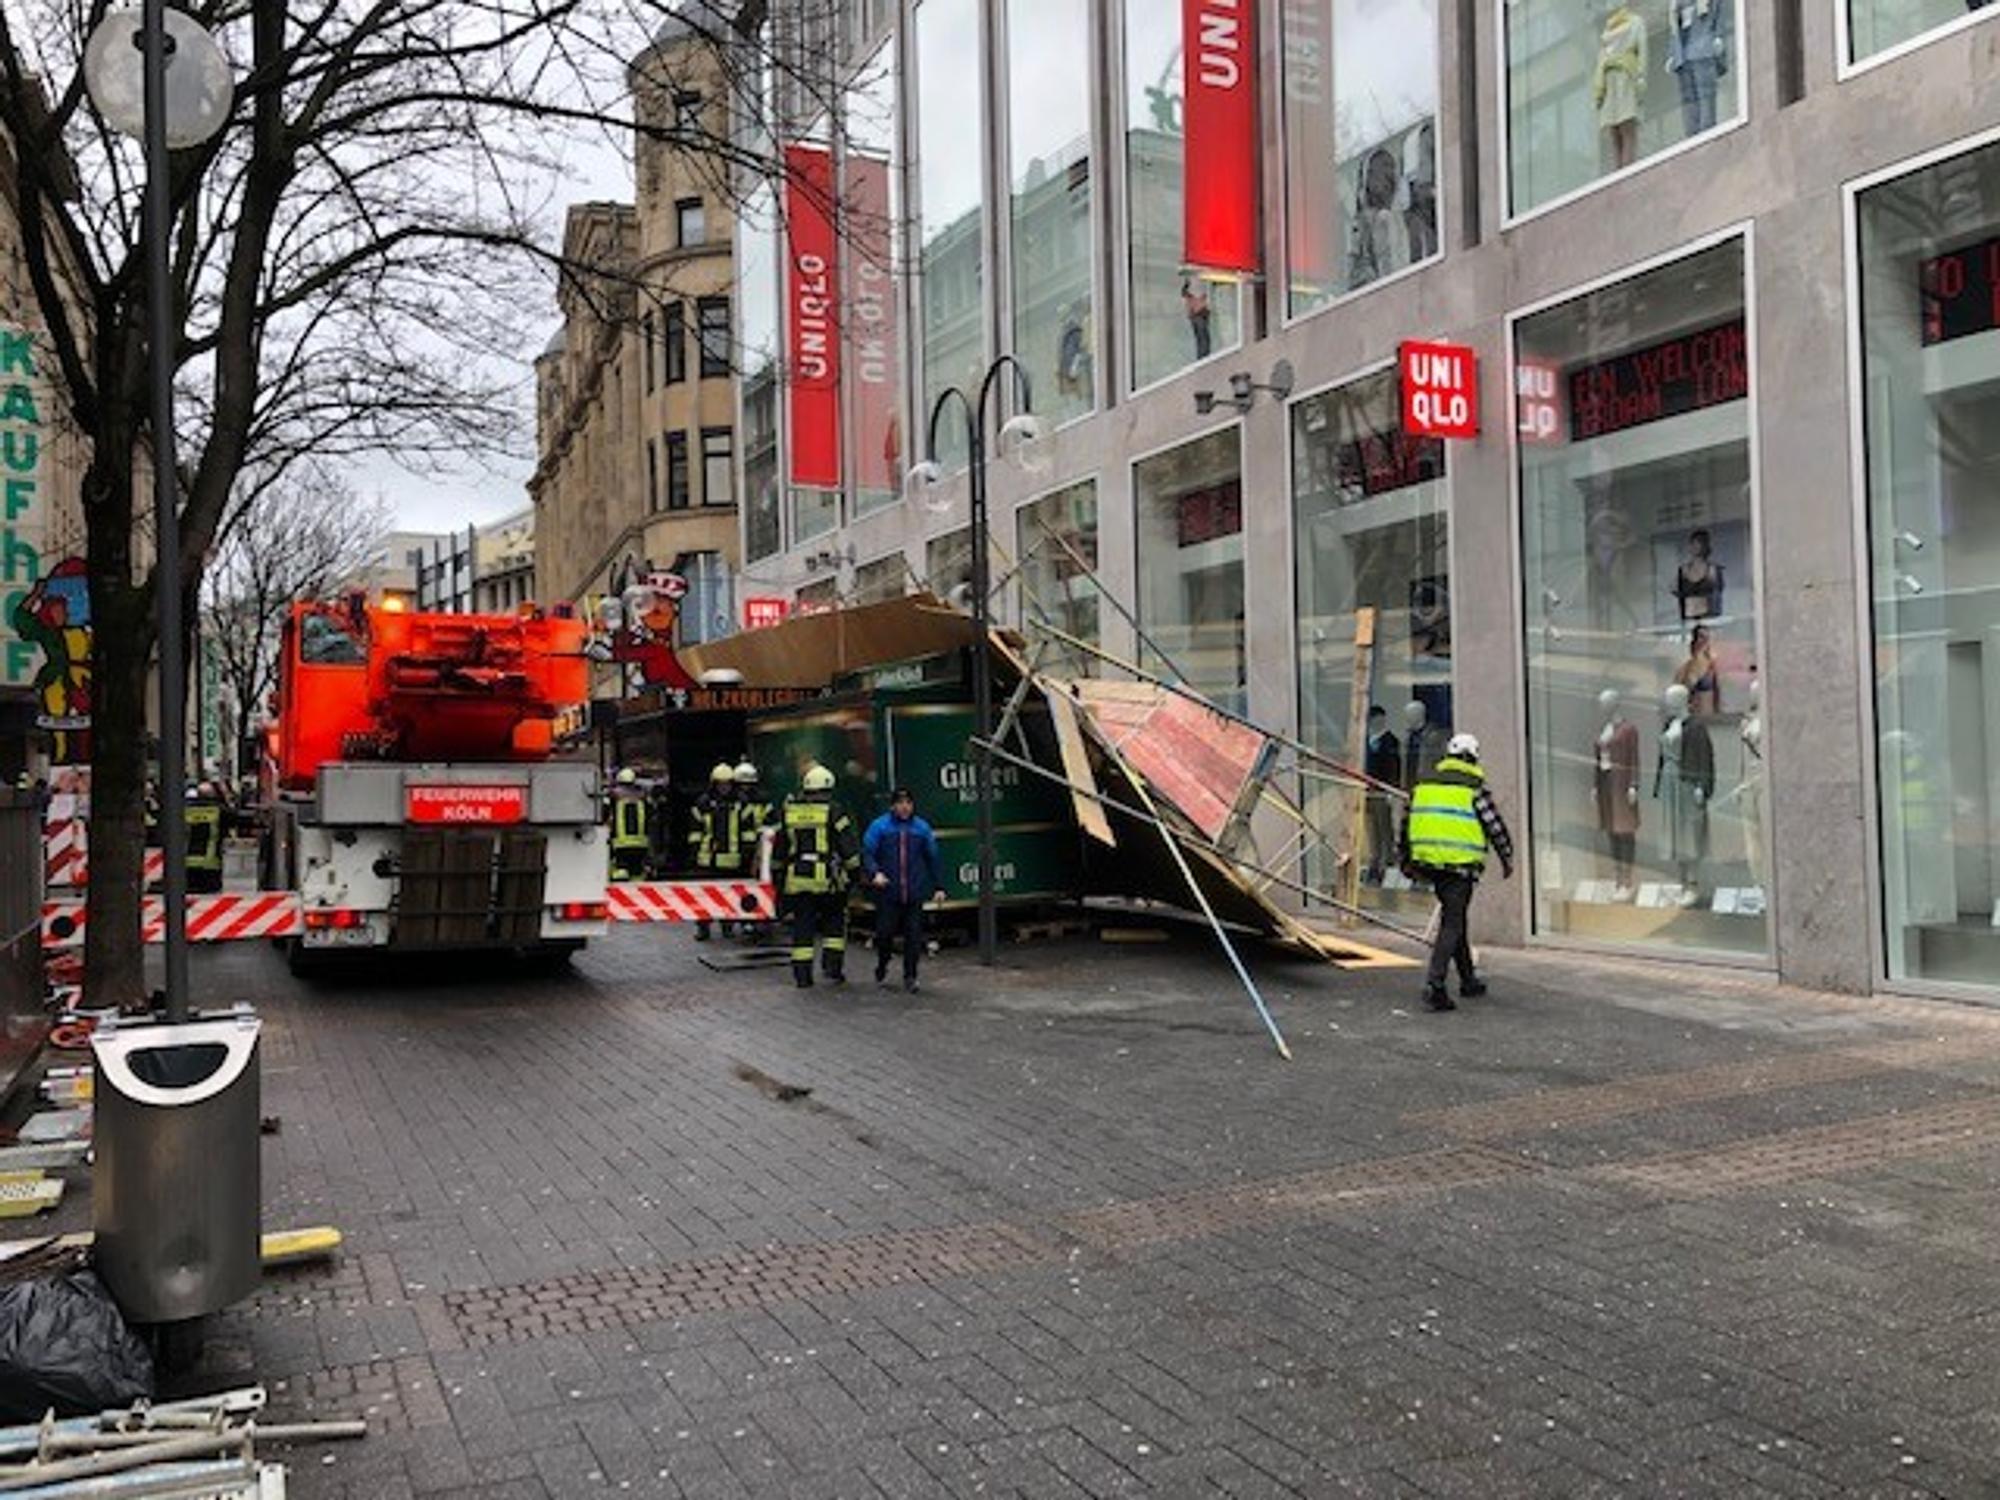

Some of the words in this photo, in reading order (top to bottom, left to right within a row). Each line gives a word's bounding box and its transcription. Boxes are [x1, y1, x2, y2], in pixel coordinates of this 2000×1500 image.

[800, 255, 827, 377] UNIQLO
[1410, 353, 1461, 389] UNI
[1413, 391, 1467, 429] QLO
[412, 788, 520, 802] FEUERWEHR
[443, 803, 492, 820] KÖLN
